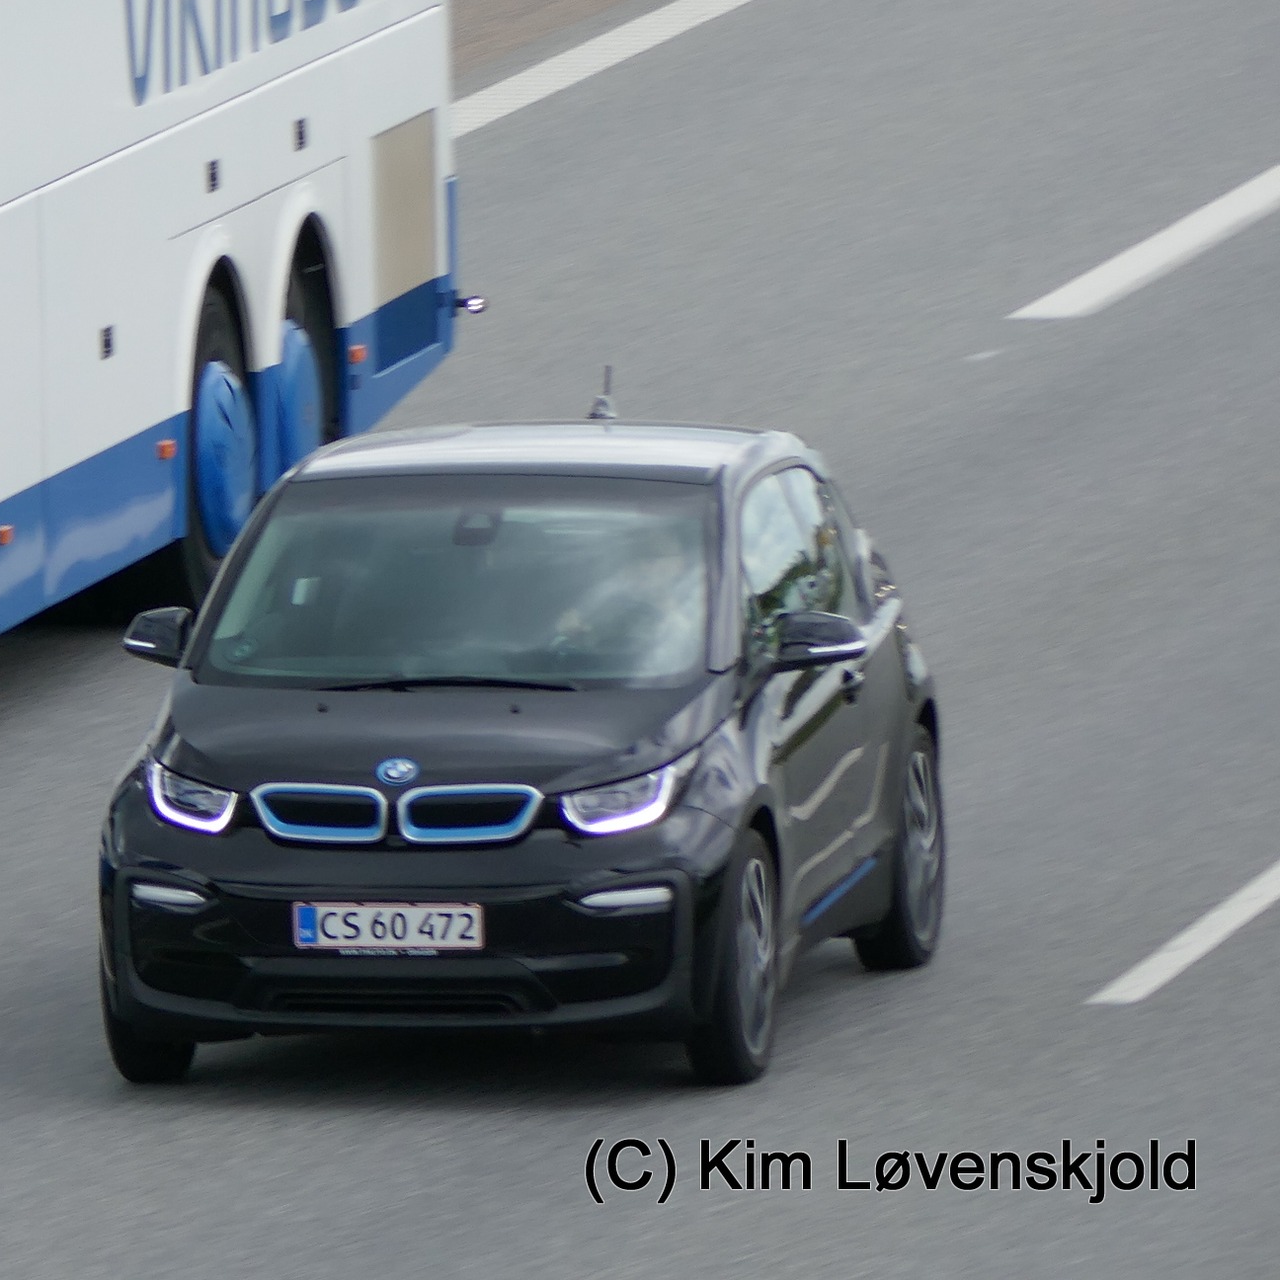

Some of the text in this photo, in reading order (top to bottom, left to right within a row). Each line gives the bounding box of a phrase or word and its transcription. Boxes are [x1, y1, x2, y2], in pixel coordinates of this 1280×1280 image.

[319, 911, 361, 940] CS
[370, 910, 408, 941] 60
[417, 911, 476, 941] 472
